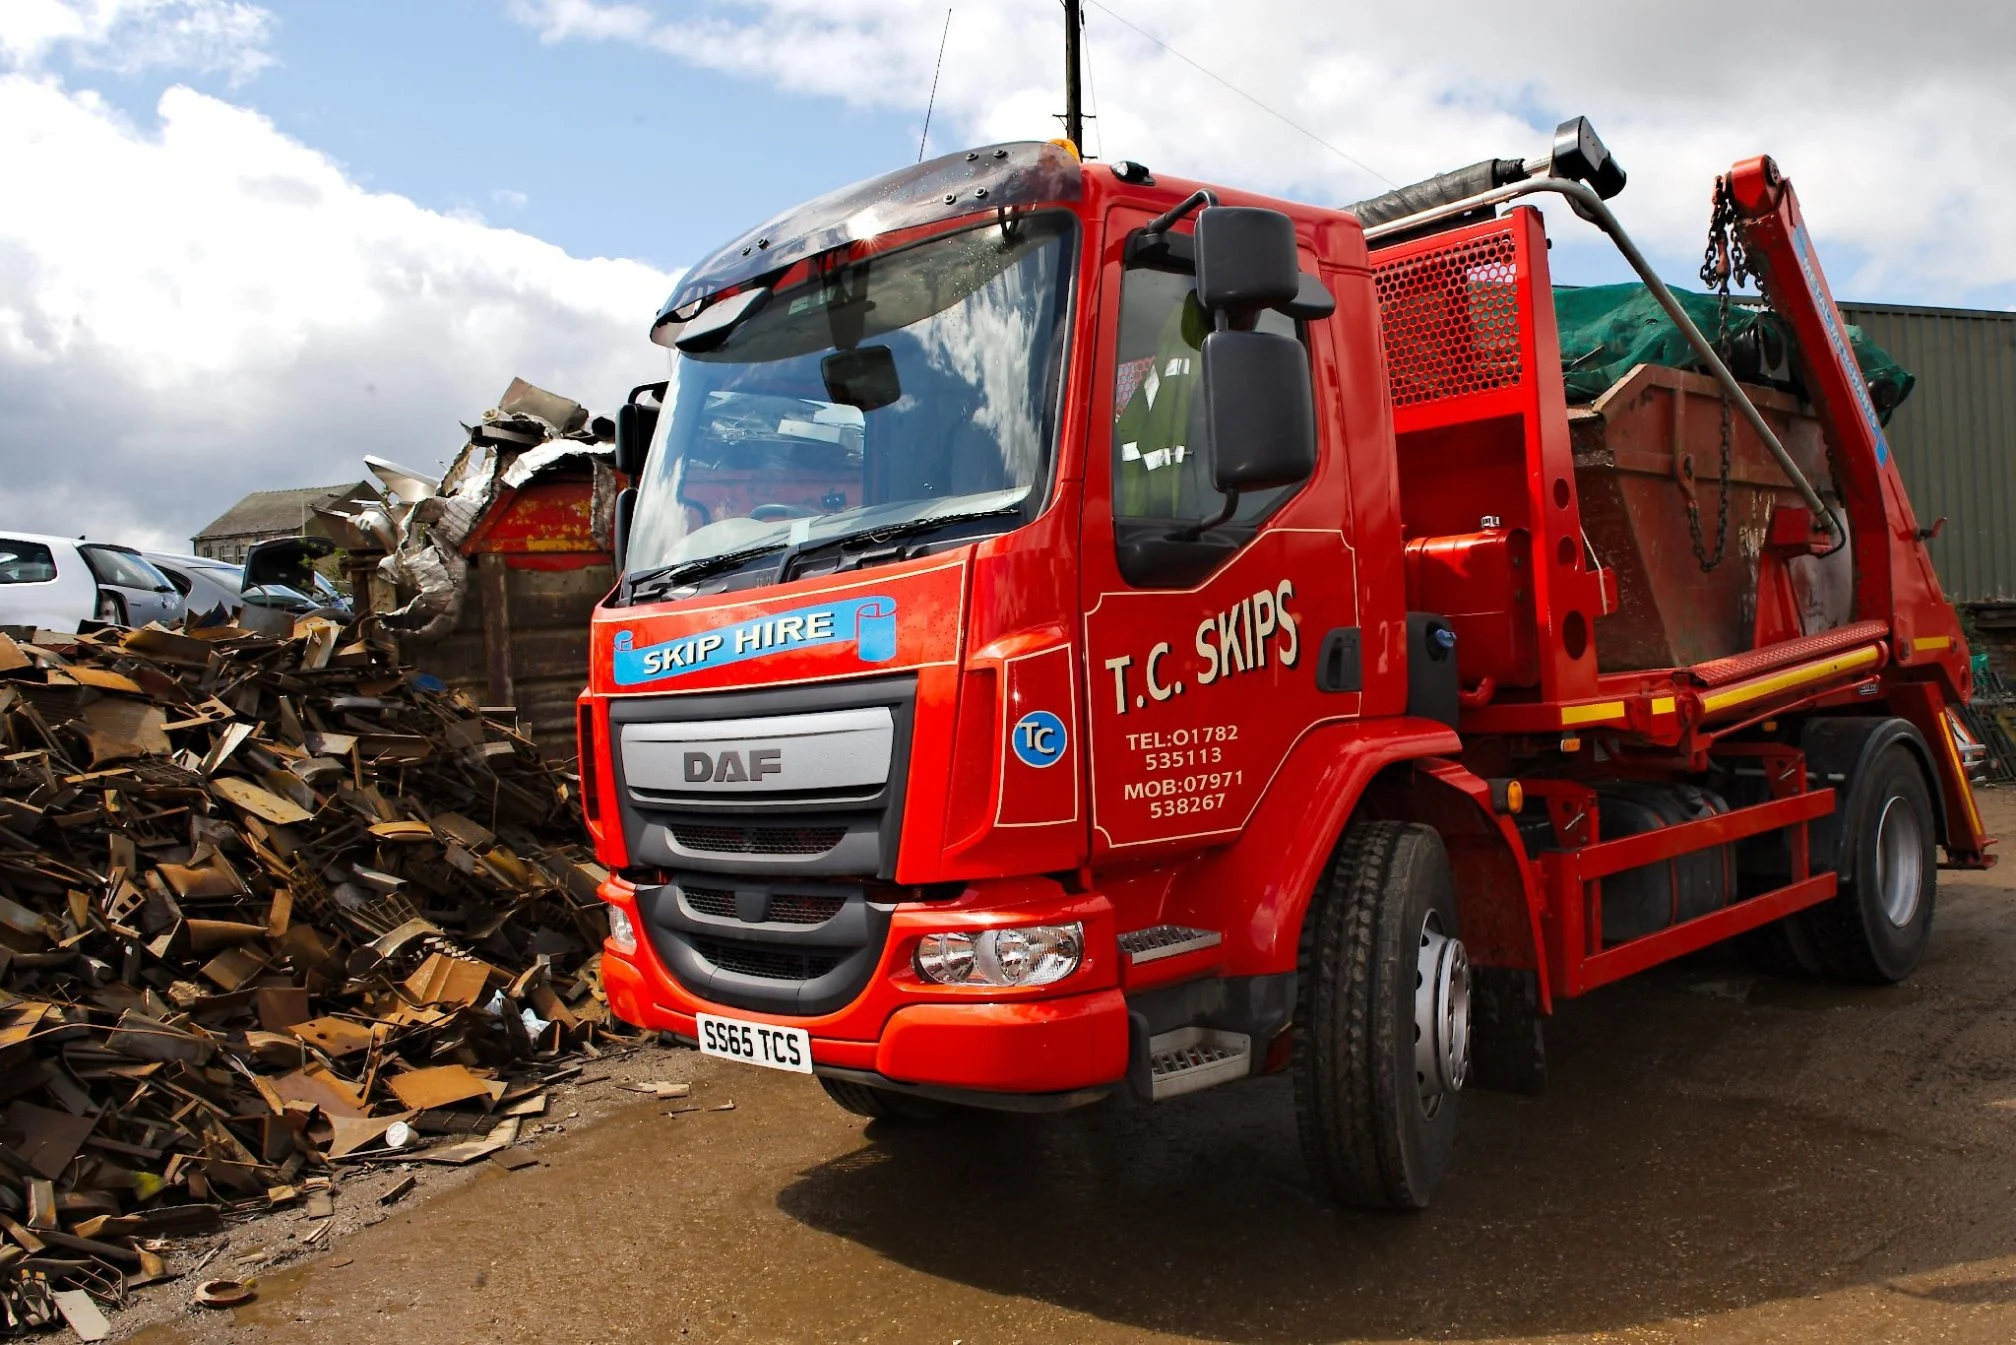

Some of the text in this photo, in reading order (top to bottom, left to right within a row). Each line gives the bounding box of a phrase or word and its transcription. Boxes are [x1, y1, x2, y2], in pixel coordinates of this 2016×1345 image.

[643, 611, 835, 675] SKIP HIRE
[1105, 578, 1298, 715] T.C. SKIPS
[1018, 721, 1056, 754] TC
[683, 748, 782, 783] DAF
[1145, 747, 1222, 771] 535113
[1124, 769, 1243, 801] MOB:07971
[1150, 792, 1226, 819] 538267
[704, 1019, 801, 1066] SS65 TCS
